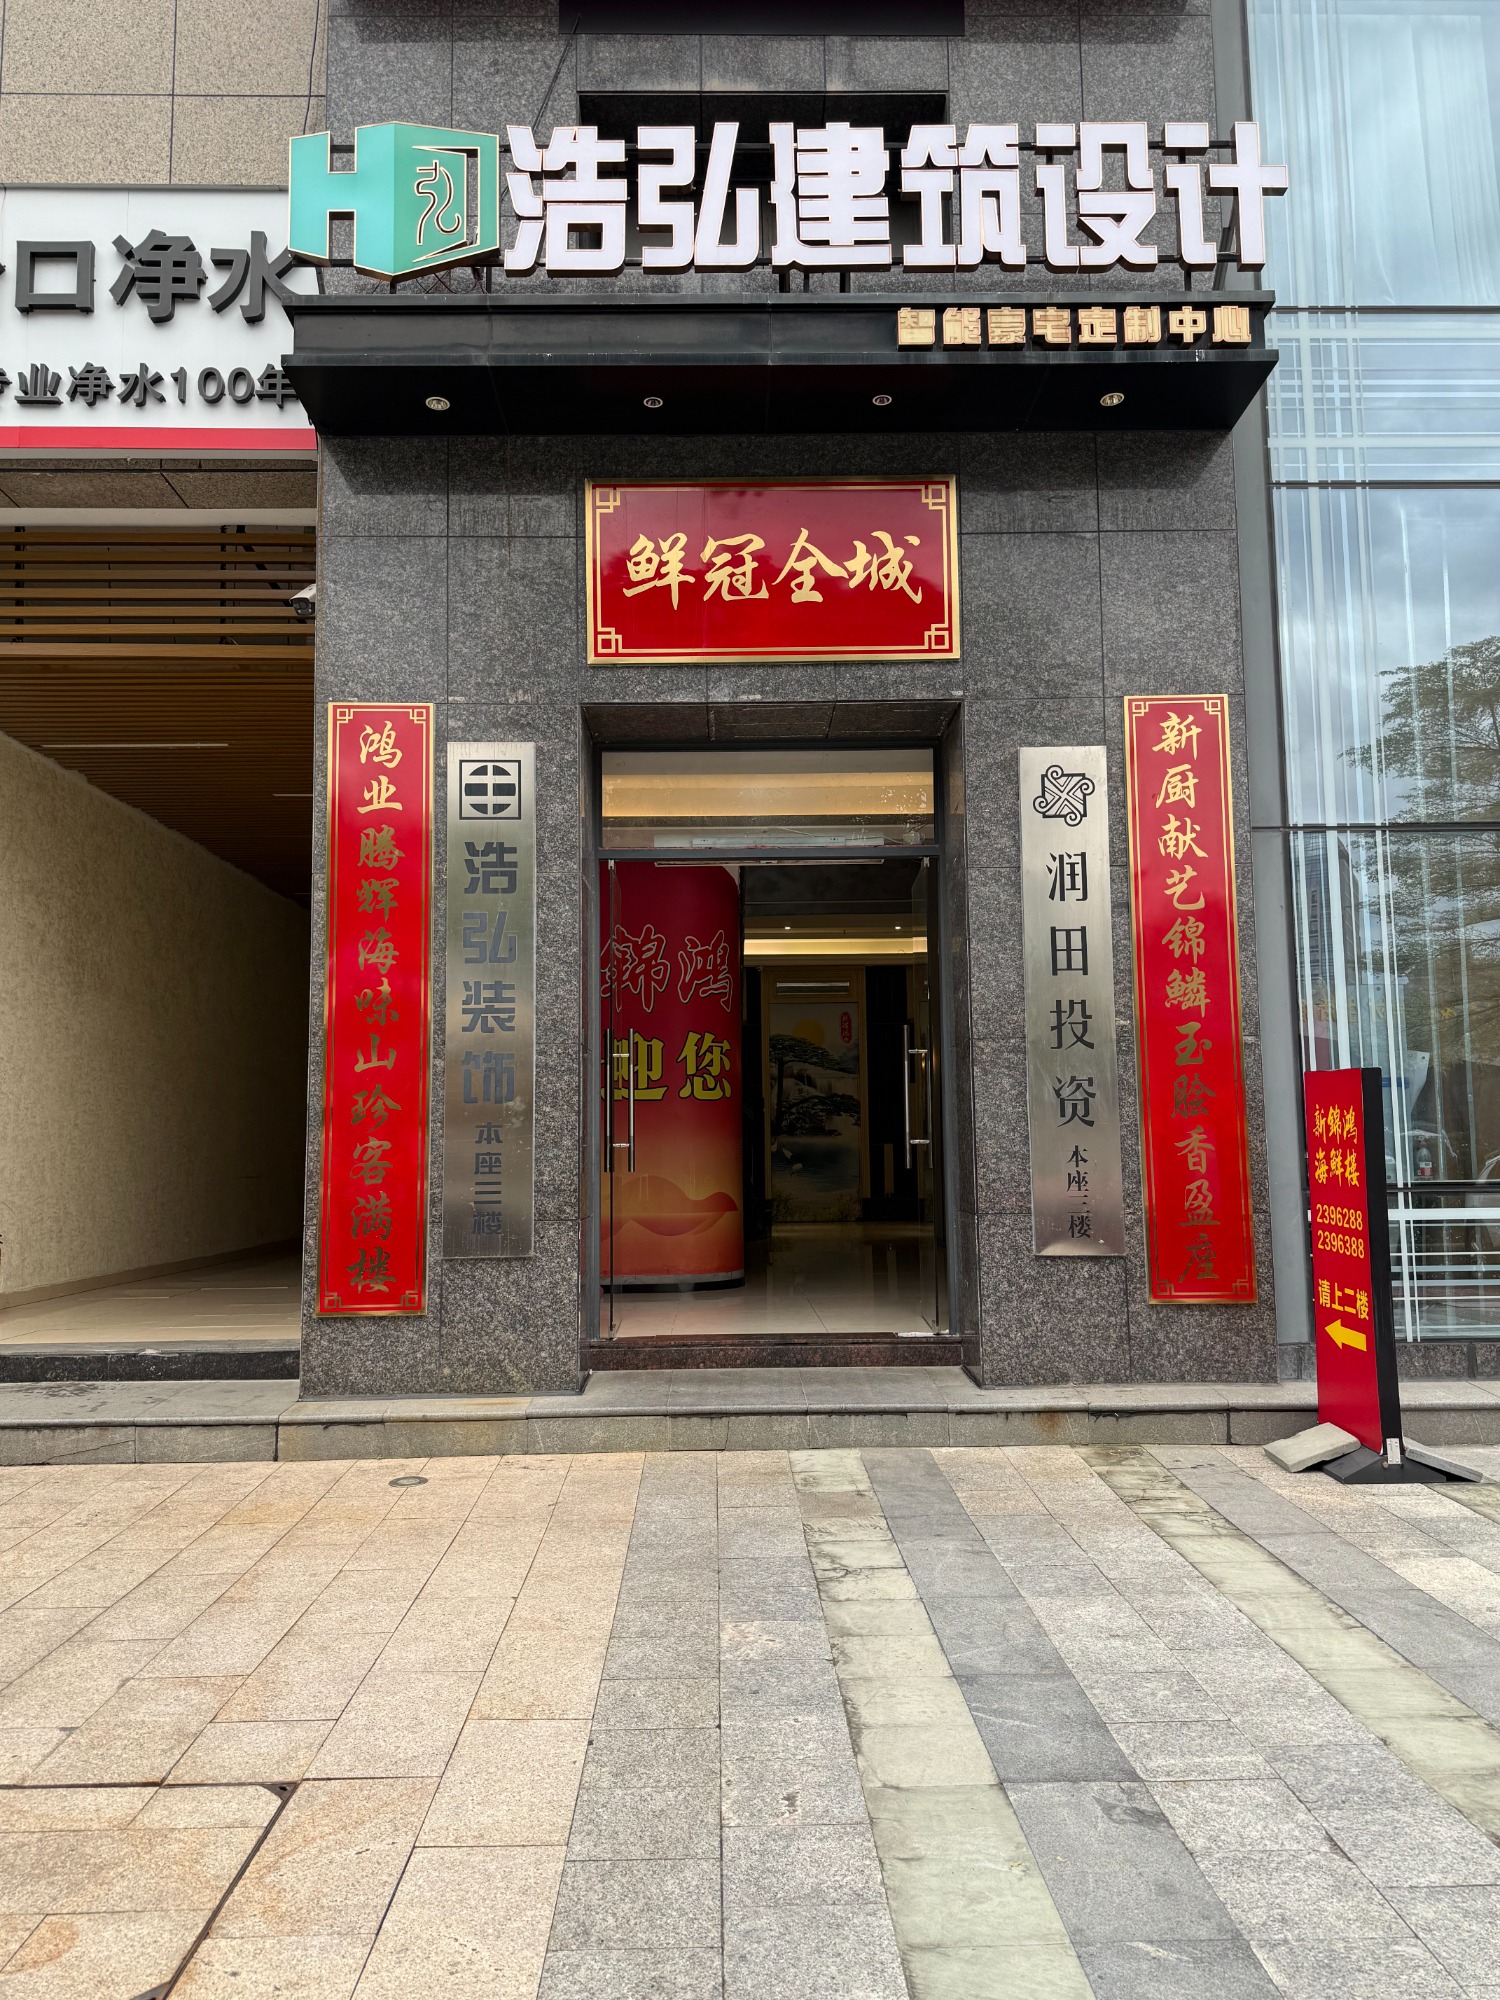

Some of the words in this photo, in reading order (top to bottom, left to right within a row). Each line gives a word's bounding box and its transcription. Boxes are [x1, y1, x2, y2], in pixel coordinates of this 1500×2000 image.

[504, 121, 1289, 272] 浩弘建筑设计
[0, 228, 302, 324] 口净水
[897, 305, 1252, 345] 智能豪宅定制中心
[622, 527, 922, 611] 鲜冠全城
[346, 720, 405, 1295] 鸿业腾辉海味山珍客满楼
[461, 841, 518, 1105] 浩弘装饰
[1045, 851, 1097, 1128] 润田投资
[473, 1121, 504, 1236] 本座三楼
[1066, 1144, 1093, 1239] 本座三楼
[1315, 1203, 1364, 1232] 2396288
[1316, 1229, 1366, 1260] 2396388
[1317, 1278, 1370, 1321] 请上二楼
